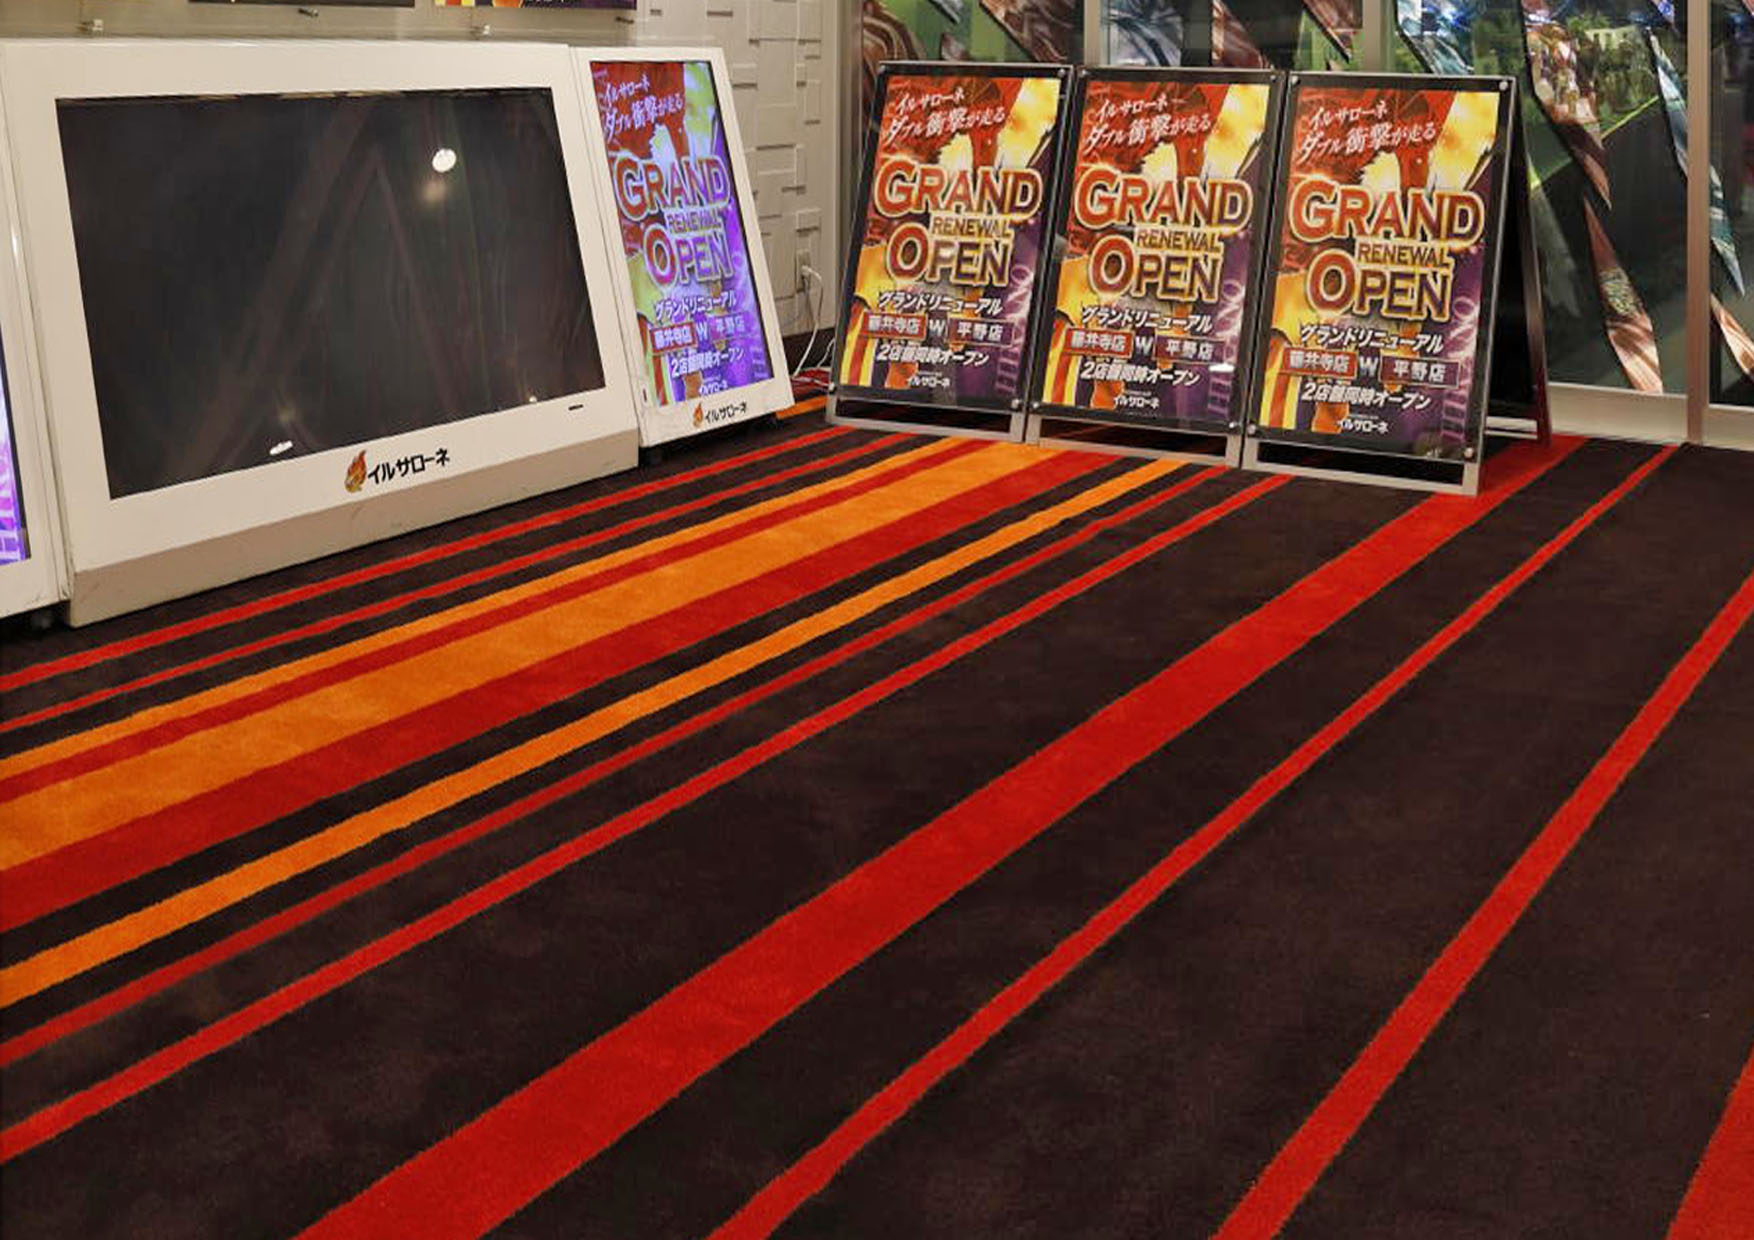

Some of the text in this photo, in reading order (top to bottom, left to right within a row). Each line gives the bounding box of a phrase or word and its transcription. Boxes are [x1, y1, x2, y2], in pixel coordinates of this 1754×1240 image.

[613, 150, 731, 222] GRAND
[874, 154, 1043, 221] GRAND
[1074, 163, 1254, 237] GRAND
[1289, 173, 1485, 249] GRAND
[930, 216, 1013, 239] RENEWAL
[1135, 228, 1223, 254] RENEWAL
[642, 223, 735, 289] OPEN
[886, 222, 1014, 287] OPEN
[1088, 234, 1224, 305] OPEN
[1356, 242, 1452, 267] RENEWAL
[1306, 247, 1454, 324] OPEN
[655, 290, 738, 321] グランドリニューアル
[877, 291, 1003, 317] グランドリニューアル
[1081, 306, 1214, 333] グランドリニューアル
[928, 319, 946, 337] W
[956, 321, 1003, 342] 平野店
[1300, 324, 1445, 355] グランドリニューアル
[1134, 335, 1154, 356] W
[1166, 340, 1215, 361] 平野店
[1357, 356, 1379, 378] W
[1393, 360, 1447, 383] 平野店
[1300, 381, 1432, 411] 2店舗同時オープン
[705, 401, 747, 423] イルサローネ
[368, 448, 451, 485] イルサローネ
